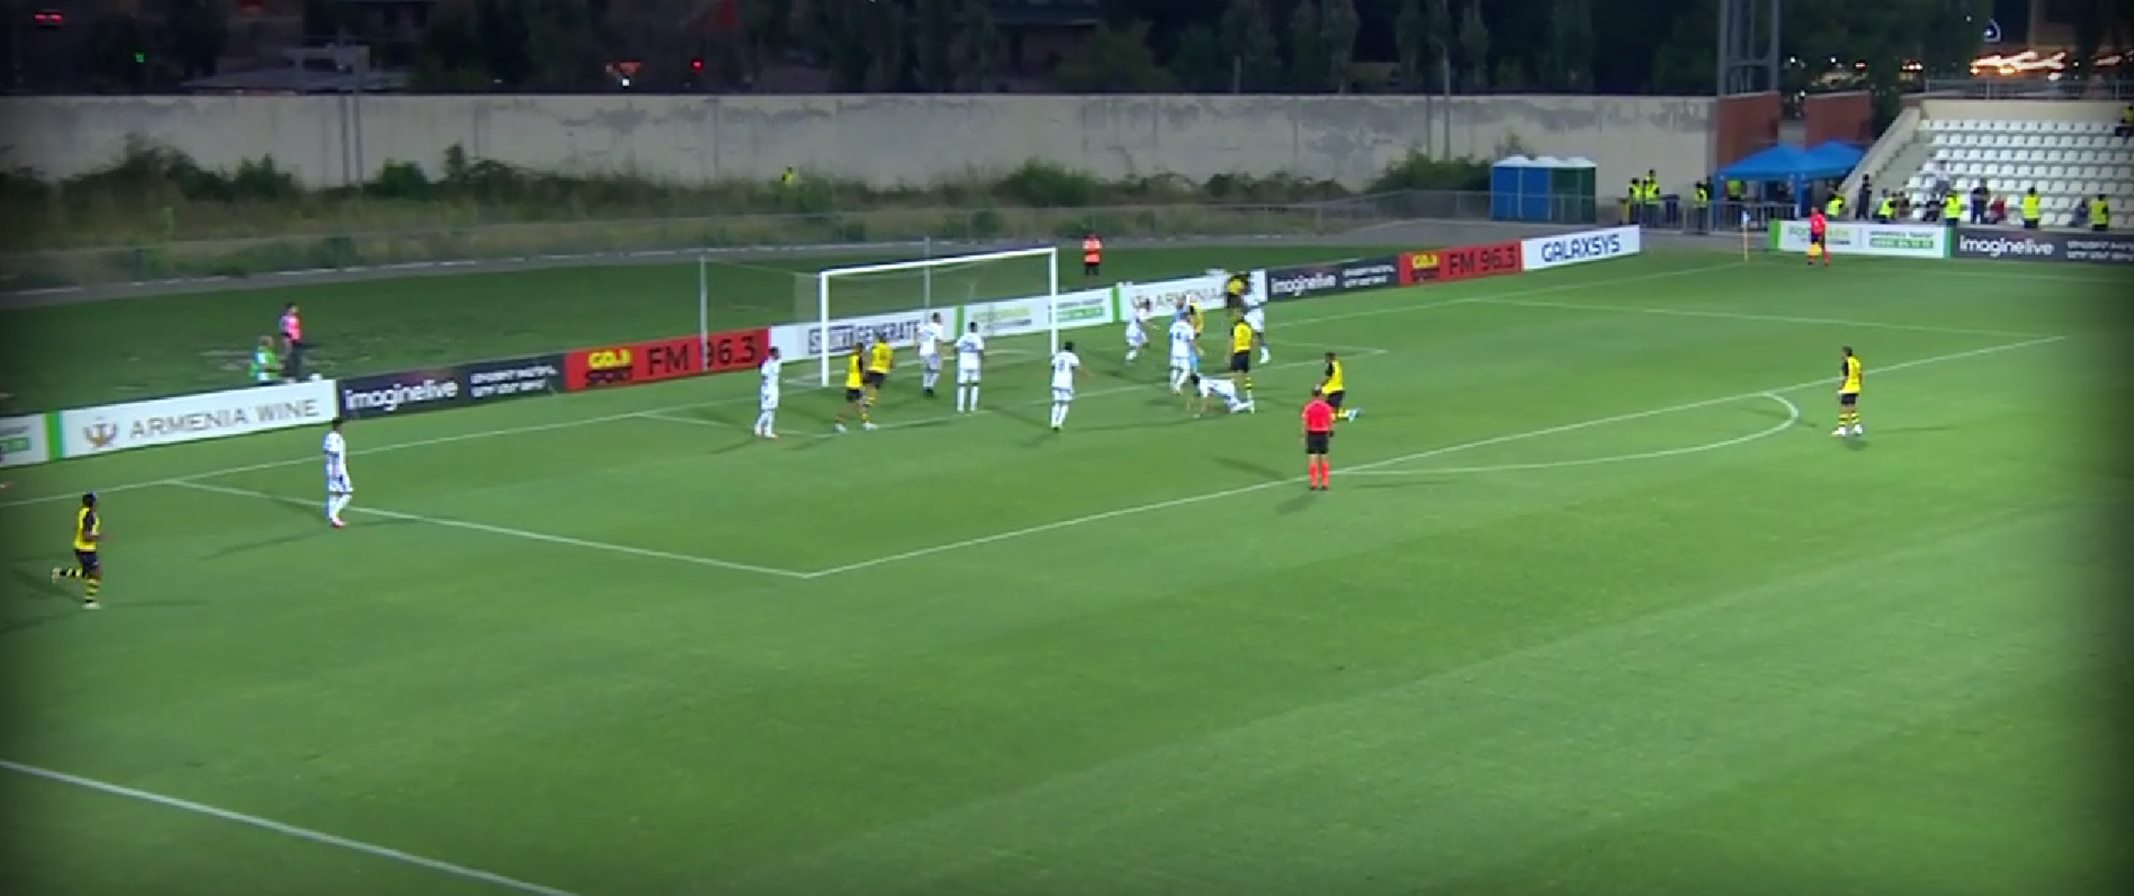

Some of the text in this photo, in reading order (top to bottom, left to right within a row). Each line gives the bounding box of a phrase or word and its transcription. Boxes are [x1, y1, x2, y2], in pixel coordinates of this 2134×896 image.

[1542, 234, 1620, 262] GALAXSYS
[1959, 234, 2054, 257] imaginelive
[1449, 247, 1515, 275] FM 96.3
[649, 343, 688, 376] FM
[344, 378, 459, 411] imaginelive
[129, 398, 320, 438] ARMENIA WINE
